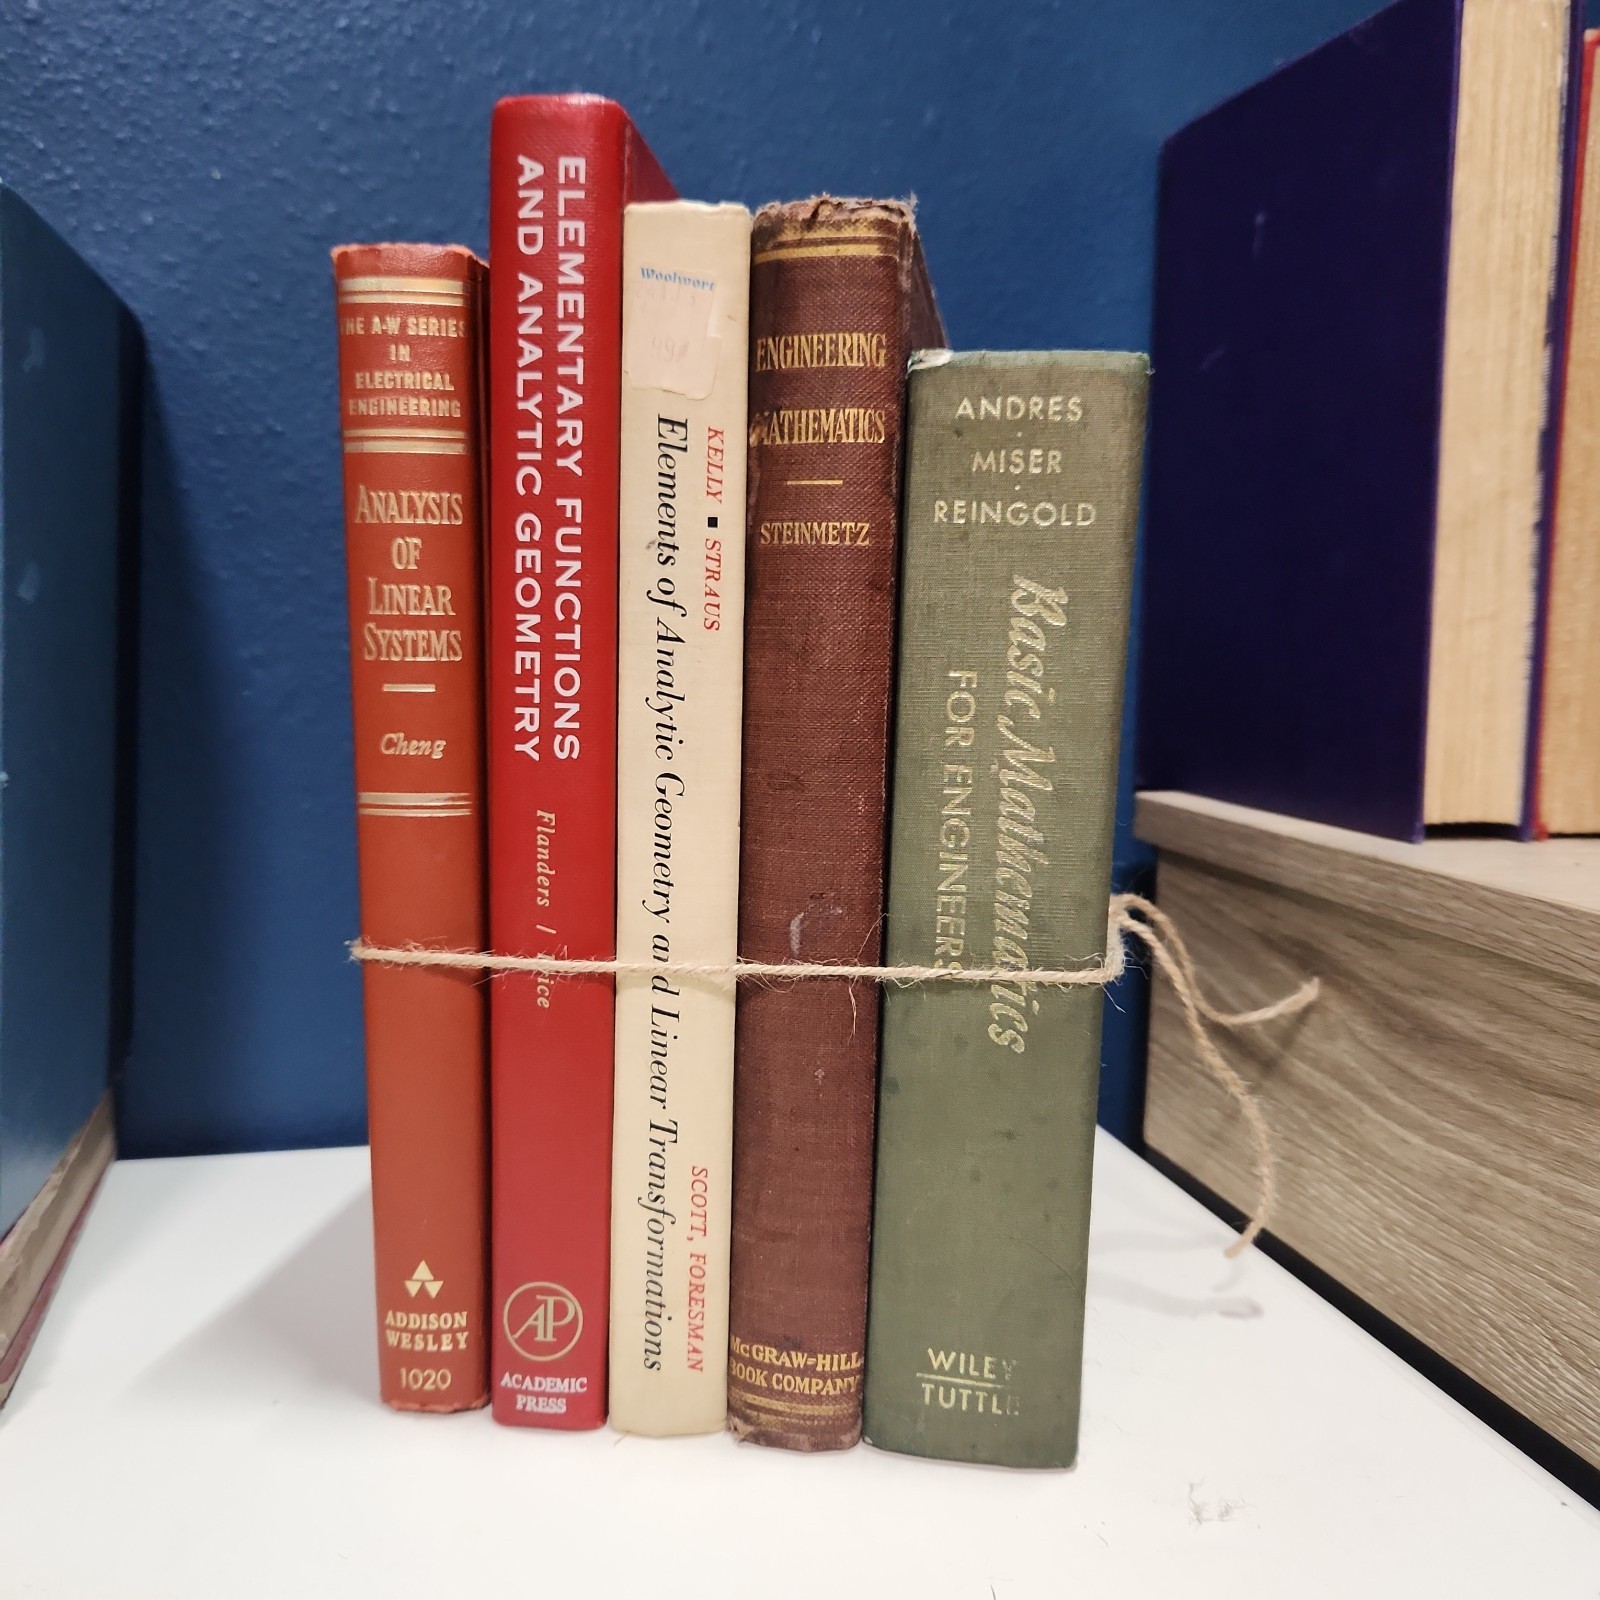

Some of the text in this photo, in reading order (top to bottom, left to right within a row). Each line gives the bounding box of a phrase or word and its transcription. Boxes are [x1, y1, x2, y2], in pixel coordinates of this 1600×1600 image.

[388, 343, 411, 362] IN
[756, 332, 887, 372] ENGINEERING
[355, 371, 455, 391] ELECTRICAL
[349, 397, 462, 418] ENGINEERING
[954, 396, 1083, 421] ANDRES
[514, 155, 544, 761] AND ANALYTIC GEOMETRY
[553, 156, 586, 760] ELEMENTARY FUNCTIONS
[971, 449, 1062, 474] MISER
[354, 485, 463, 525] ANALYSIS
[657, 413, 688, 566] Elements
[703, 426, 725, 631] KELLY STRAUS
[933, 500, 1097, 526] REINGOLD
[391, 537, 422, 570] OF
[760, 521, 871, 546] STEINMETZ
[367, 577, 457, 616] LINEAR
[646, 577, 688, 618] of
[364, 622, 463, 662] SYSTEMS
[1004, 574, 1069, 719] Basic
[645, 617, 686, 760] Analytic
[945, 670, 977, 747] FOR
[380, 732, 447, 759] Cheng
[536, 809, 556, 907] Flanders
[642, 772, 686, 924] Geometry
[536, 953, 556, 1008] ice
[649, 1004, 680, 1110] Linear
[637, 1119, 678, 1371] Transformations
[686, 1165, 708, 1372] SCOTT, FORESMAN
[385, 1310, 468, 1330] ADDISON
[512, 1294, 576, 1341] AP
[385, 1330, 469, 1352] WESLEY
[400, 1368, 452, 1391] 1020
[500, 1371, 587, 1393] ACADEMIC
[772, 1373, 860, 1396] COMPANY
[515, 1394, 567, 1414] PRESS
